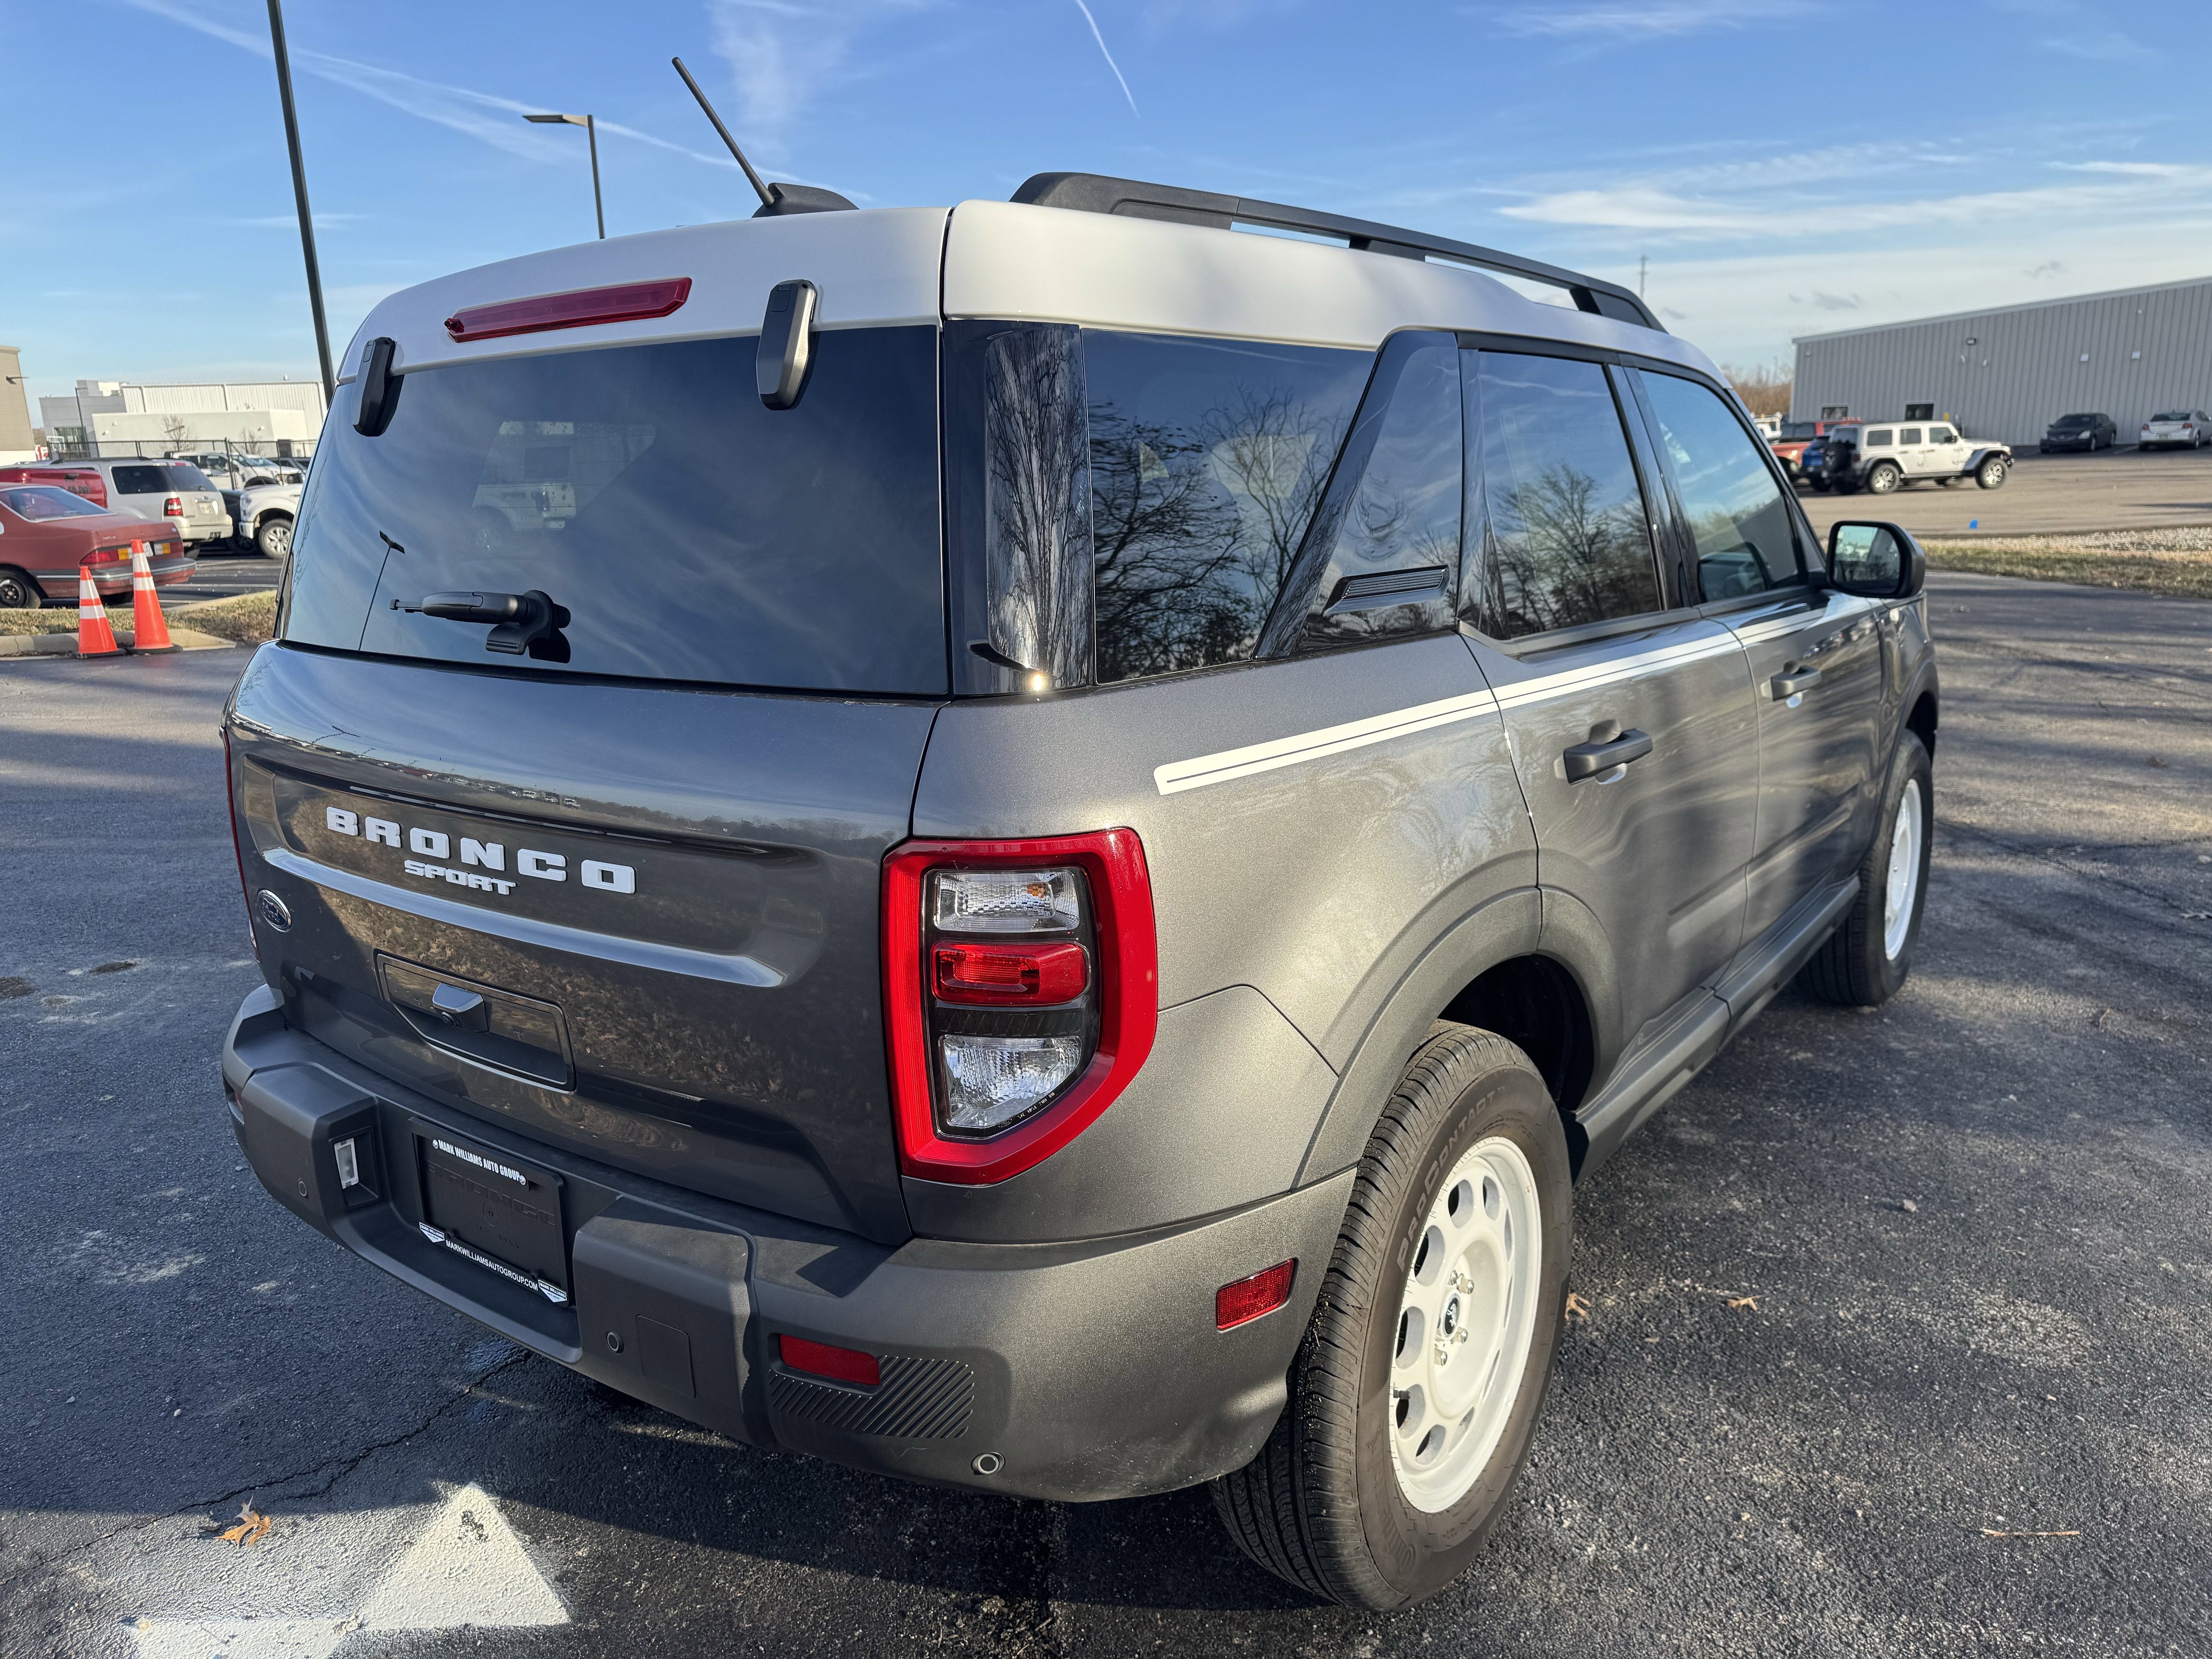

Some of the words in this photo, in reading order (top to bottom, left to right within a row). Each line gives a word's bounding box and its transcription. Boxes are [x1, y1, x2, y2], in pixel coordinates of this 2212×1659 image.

[326, 806, 636, 894] BRONCO
[404, 859, 516, 895] SPORT
[438, 1140, 455, 1155] MARK
[454, 1147, 483, 1167] WILLIAMS
[483, 1159, 499, 1173] AUTO
[500, 1165, 520, 1181] GROUP
[446, 1240, 538, 1291] MARKWILLIAMSAUTOGROUP.COM
